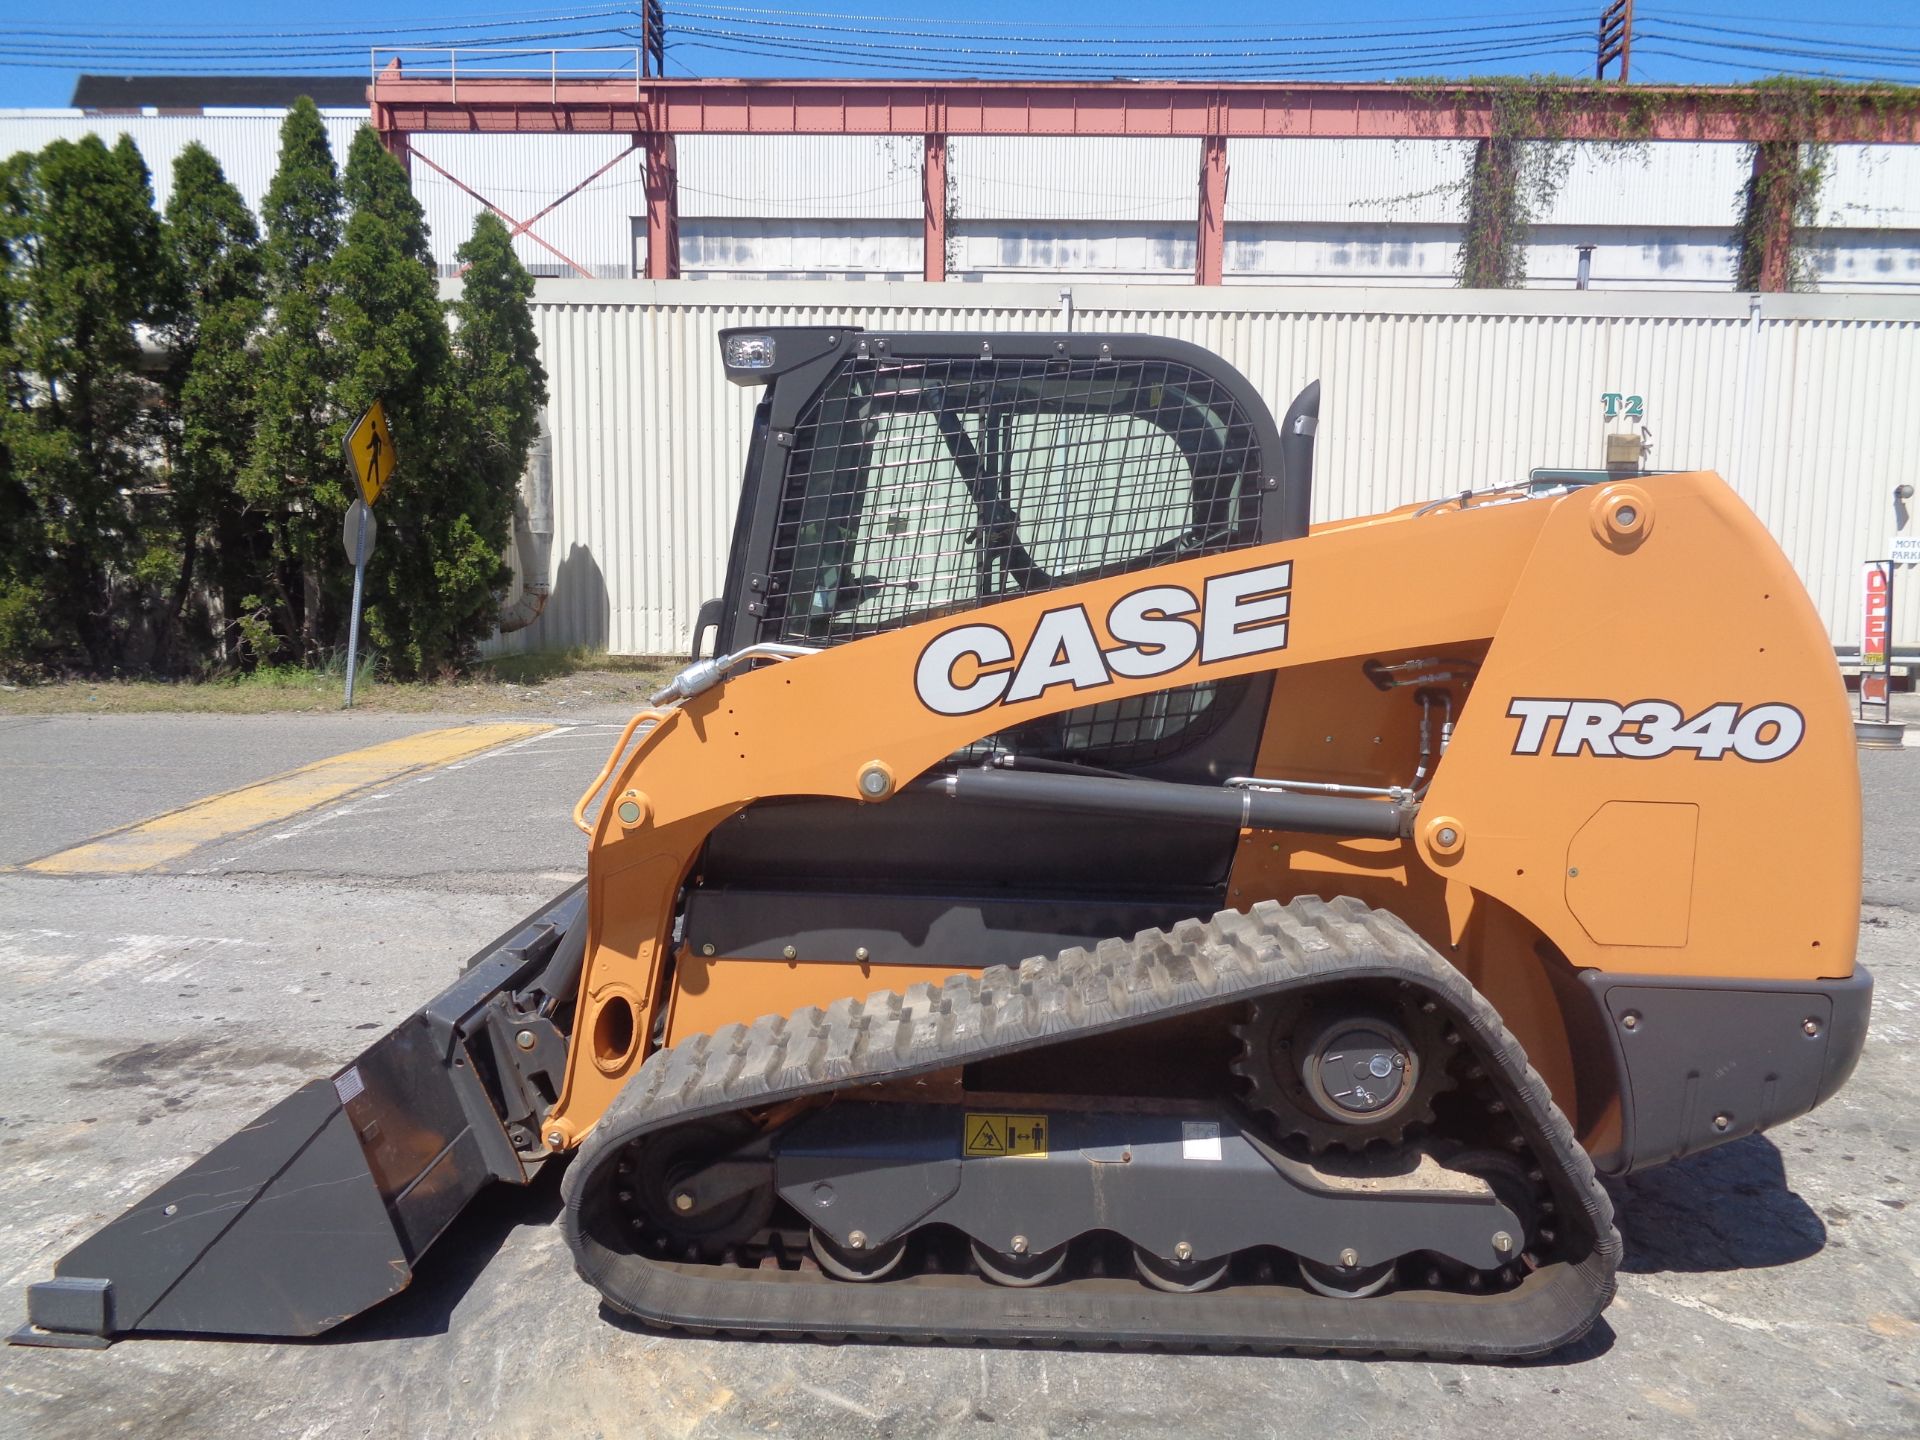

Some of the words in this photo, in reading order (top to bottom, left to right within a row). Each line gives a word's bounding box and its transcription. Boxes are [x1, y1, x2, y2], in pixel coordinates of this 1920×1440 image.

[914, 560, 1293, 717] CASE
[1865, 570, 1887, 654] OPEN
[1505, 697, 1805, 763] TR340
